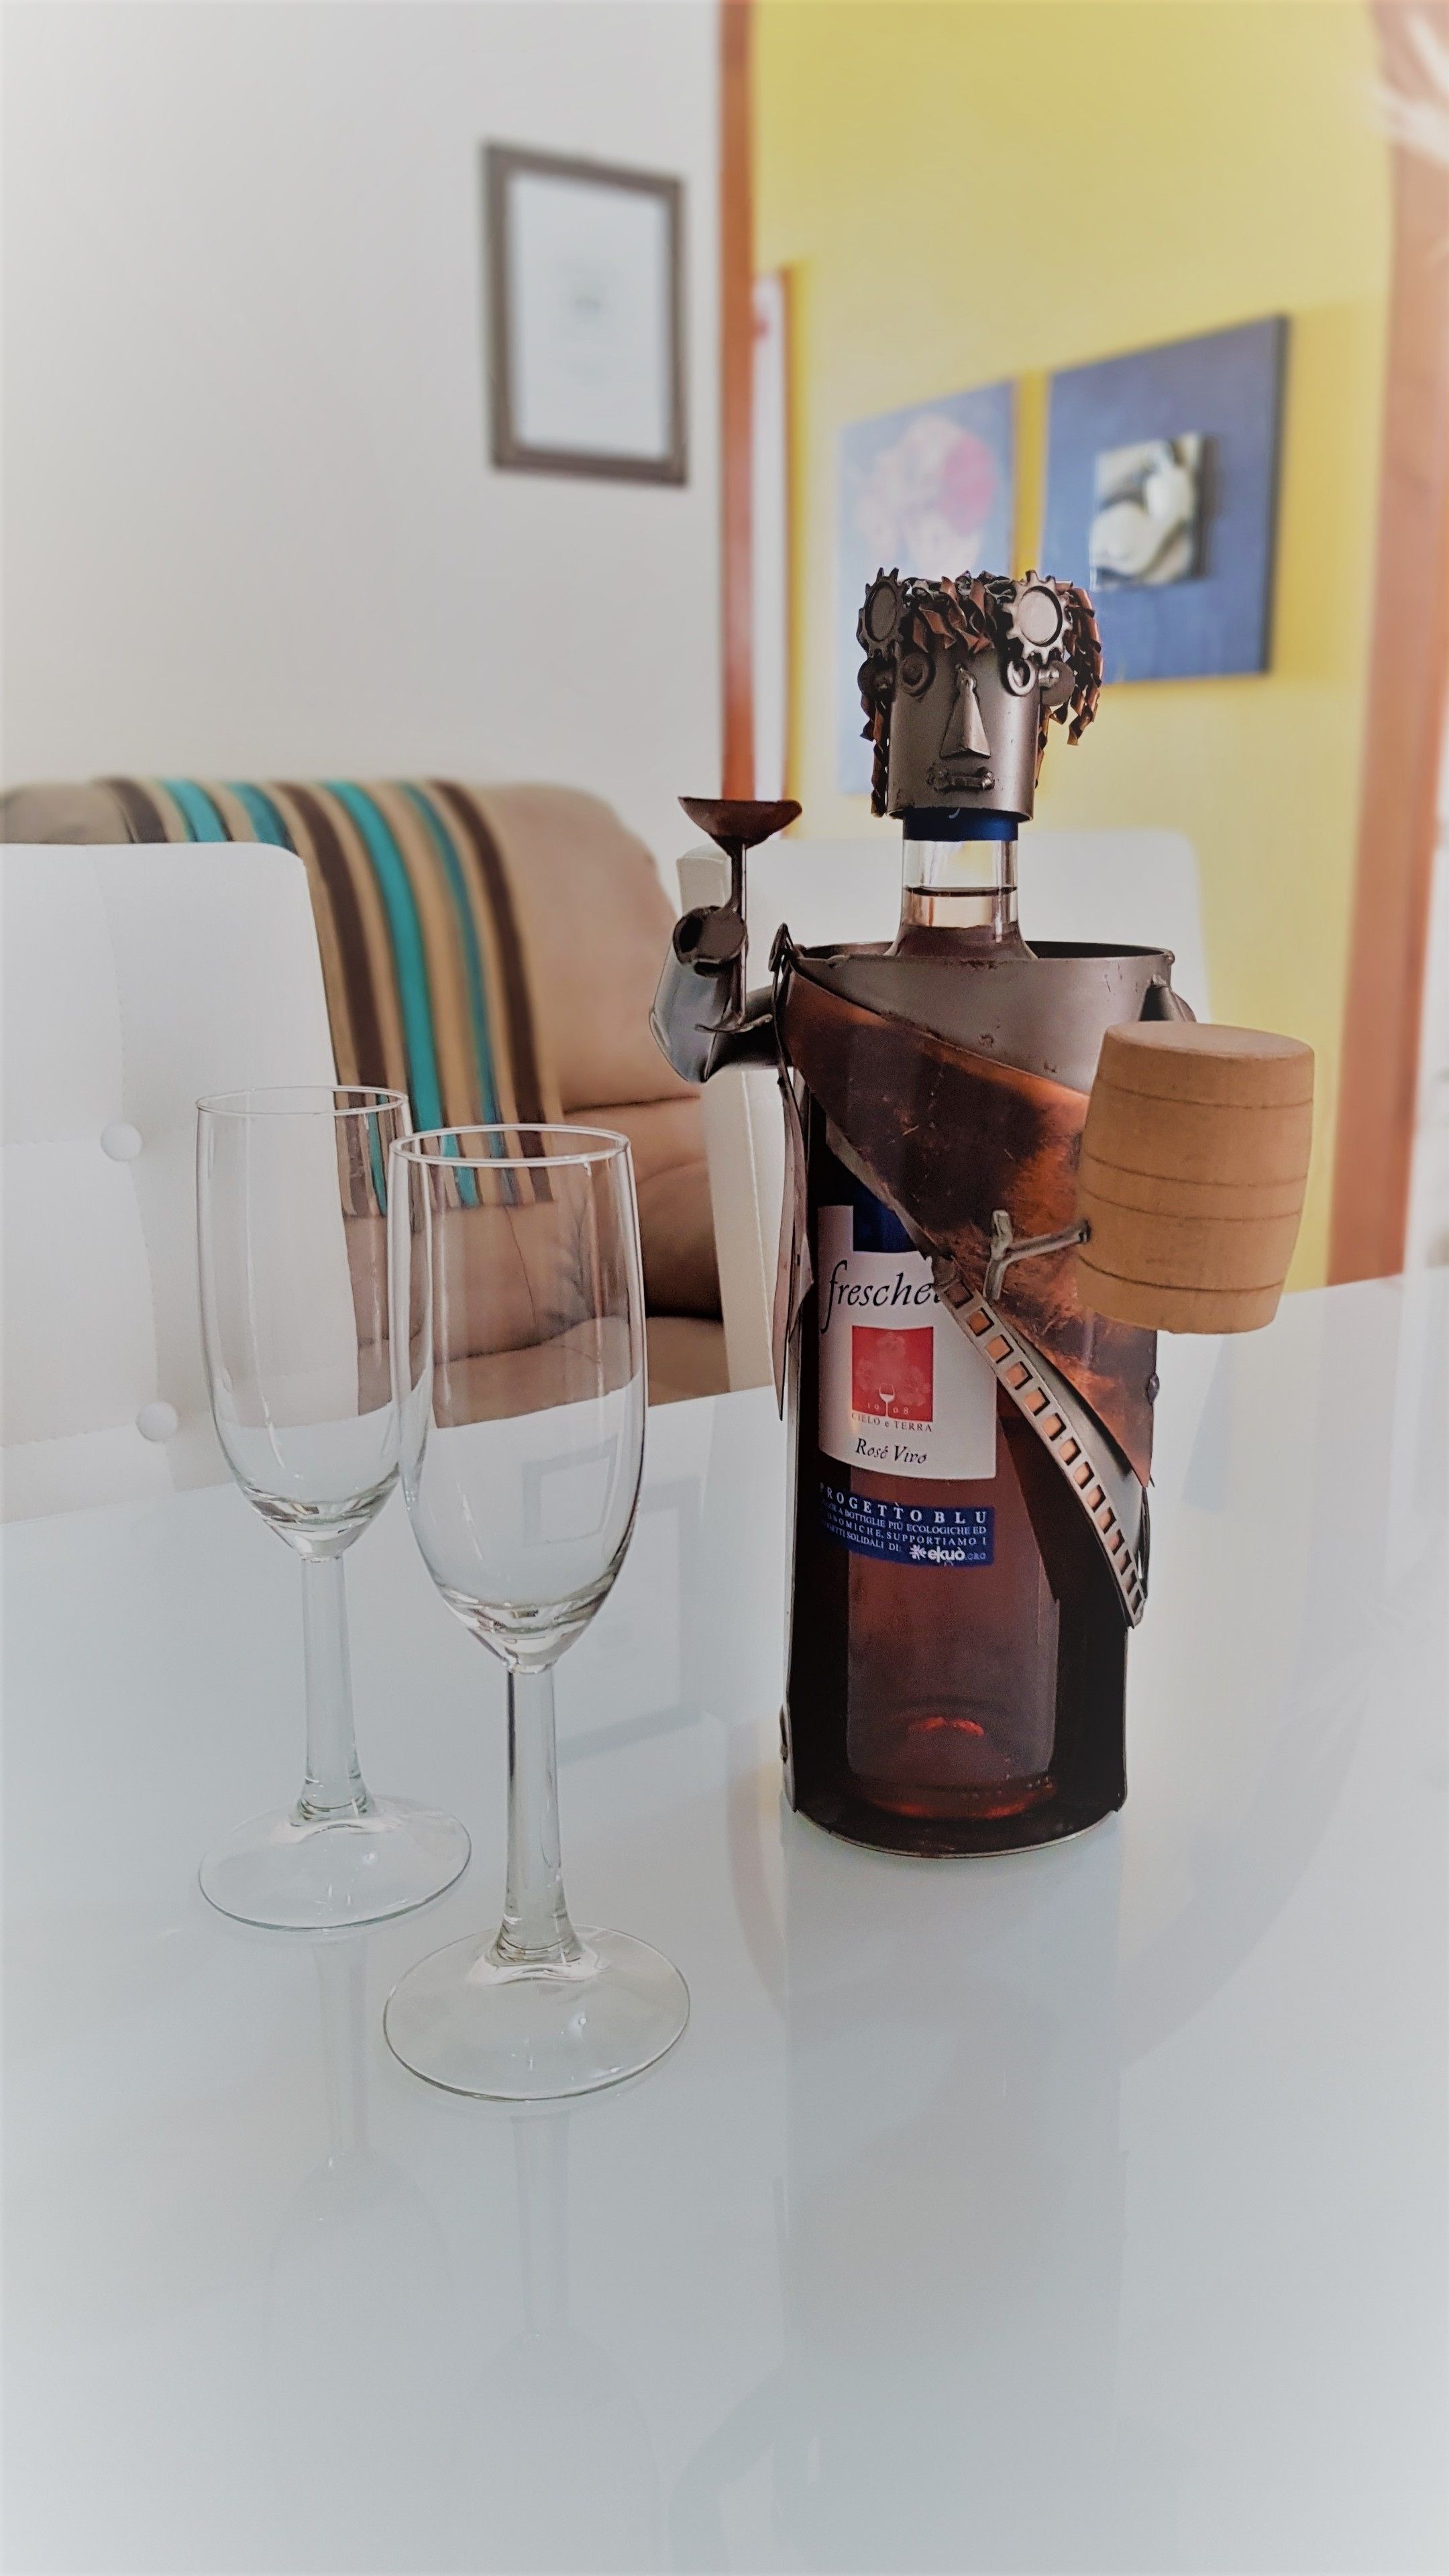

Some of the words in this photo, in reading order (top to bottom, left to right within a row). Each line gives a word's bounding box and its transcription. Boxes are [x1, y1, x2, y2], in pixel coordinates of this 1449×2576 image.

[852, 1413, 880, 1426] CIELO
[894, 1420, 932, 1432] TERRA
[855, 1438, 888, 1459] Rosé
[845, 1509, 885, 1527] BOTTIGLIE
[907, 1523, 970, 1535] ECOLOGICHE
[973, 1526, 987, 1534] ED
[934, 1511, 986, 1523] BLU
[847, 1531, 883, 1549] SOLIDALI
[886, 1531, 977, 1546] SUPPORTIAMO
